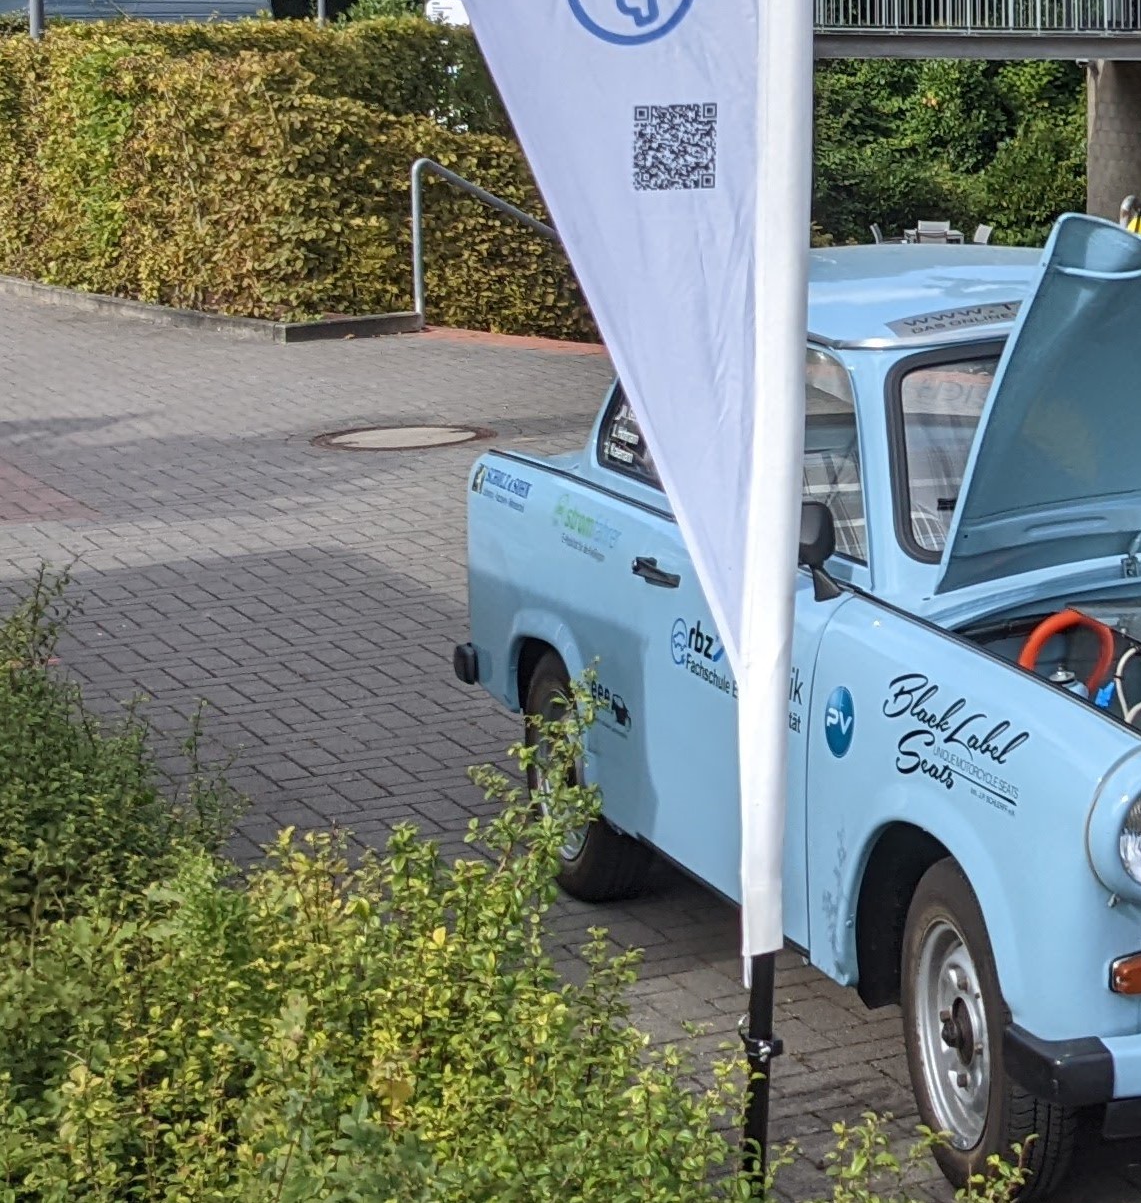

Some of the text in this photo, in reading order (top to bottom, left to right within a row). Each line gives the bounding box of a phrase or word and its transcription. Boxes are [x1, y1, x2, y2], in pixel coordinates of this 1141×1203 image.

[911, 323, 946, 334] DAS
[688, 620, 715, 660] rbz
[685, 653, 731, 694] Fachschule
[826, 707, 852, 735] PV
[883, 673, 1030, 765] Black Label
[895, 729, 955, 790] Seats
[955, 756, 998, 789] MOTORCYCLE
[999, 779, 1019, 800] SEATS
